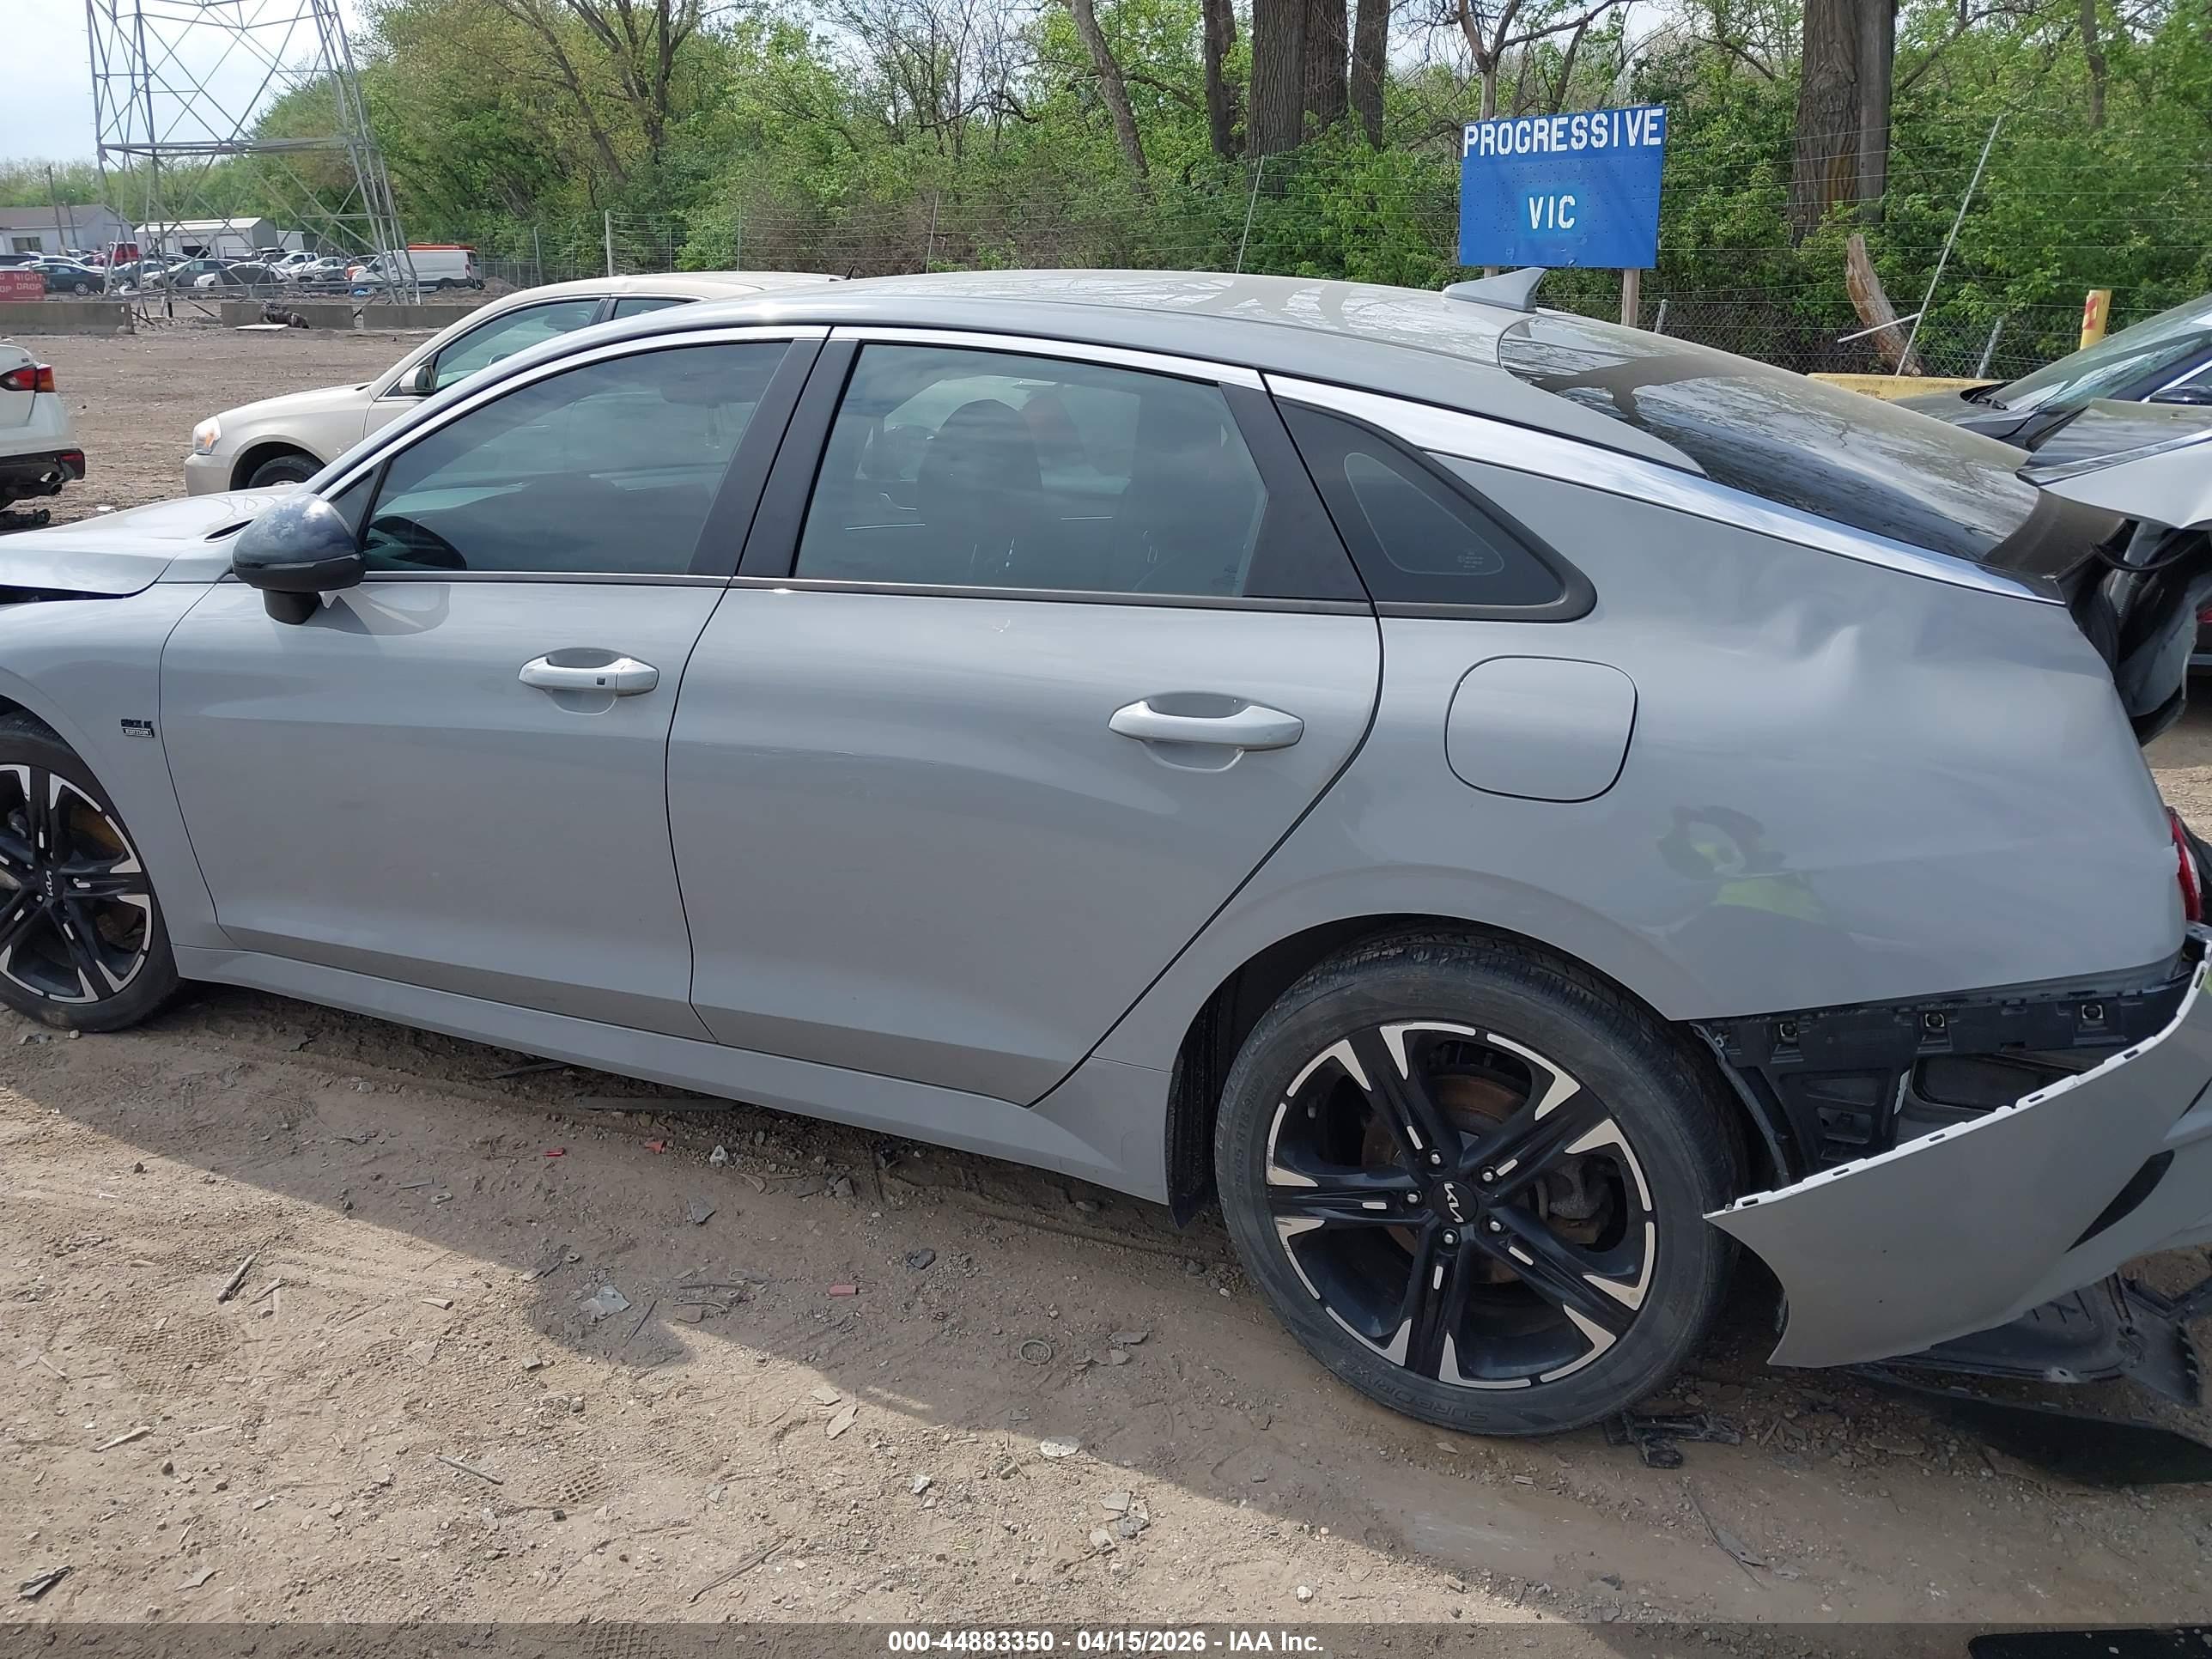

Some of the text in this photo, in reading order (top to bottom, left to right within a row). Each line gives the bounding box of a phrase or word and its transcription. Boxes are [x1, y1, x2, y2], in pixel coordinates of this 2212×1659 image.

[1463, 108, 1663, 157] PROGRESSIVE
[1528, 195, 1576, 229] VIC
[13, 272, 43, 282] NIGHT
